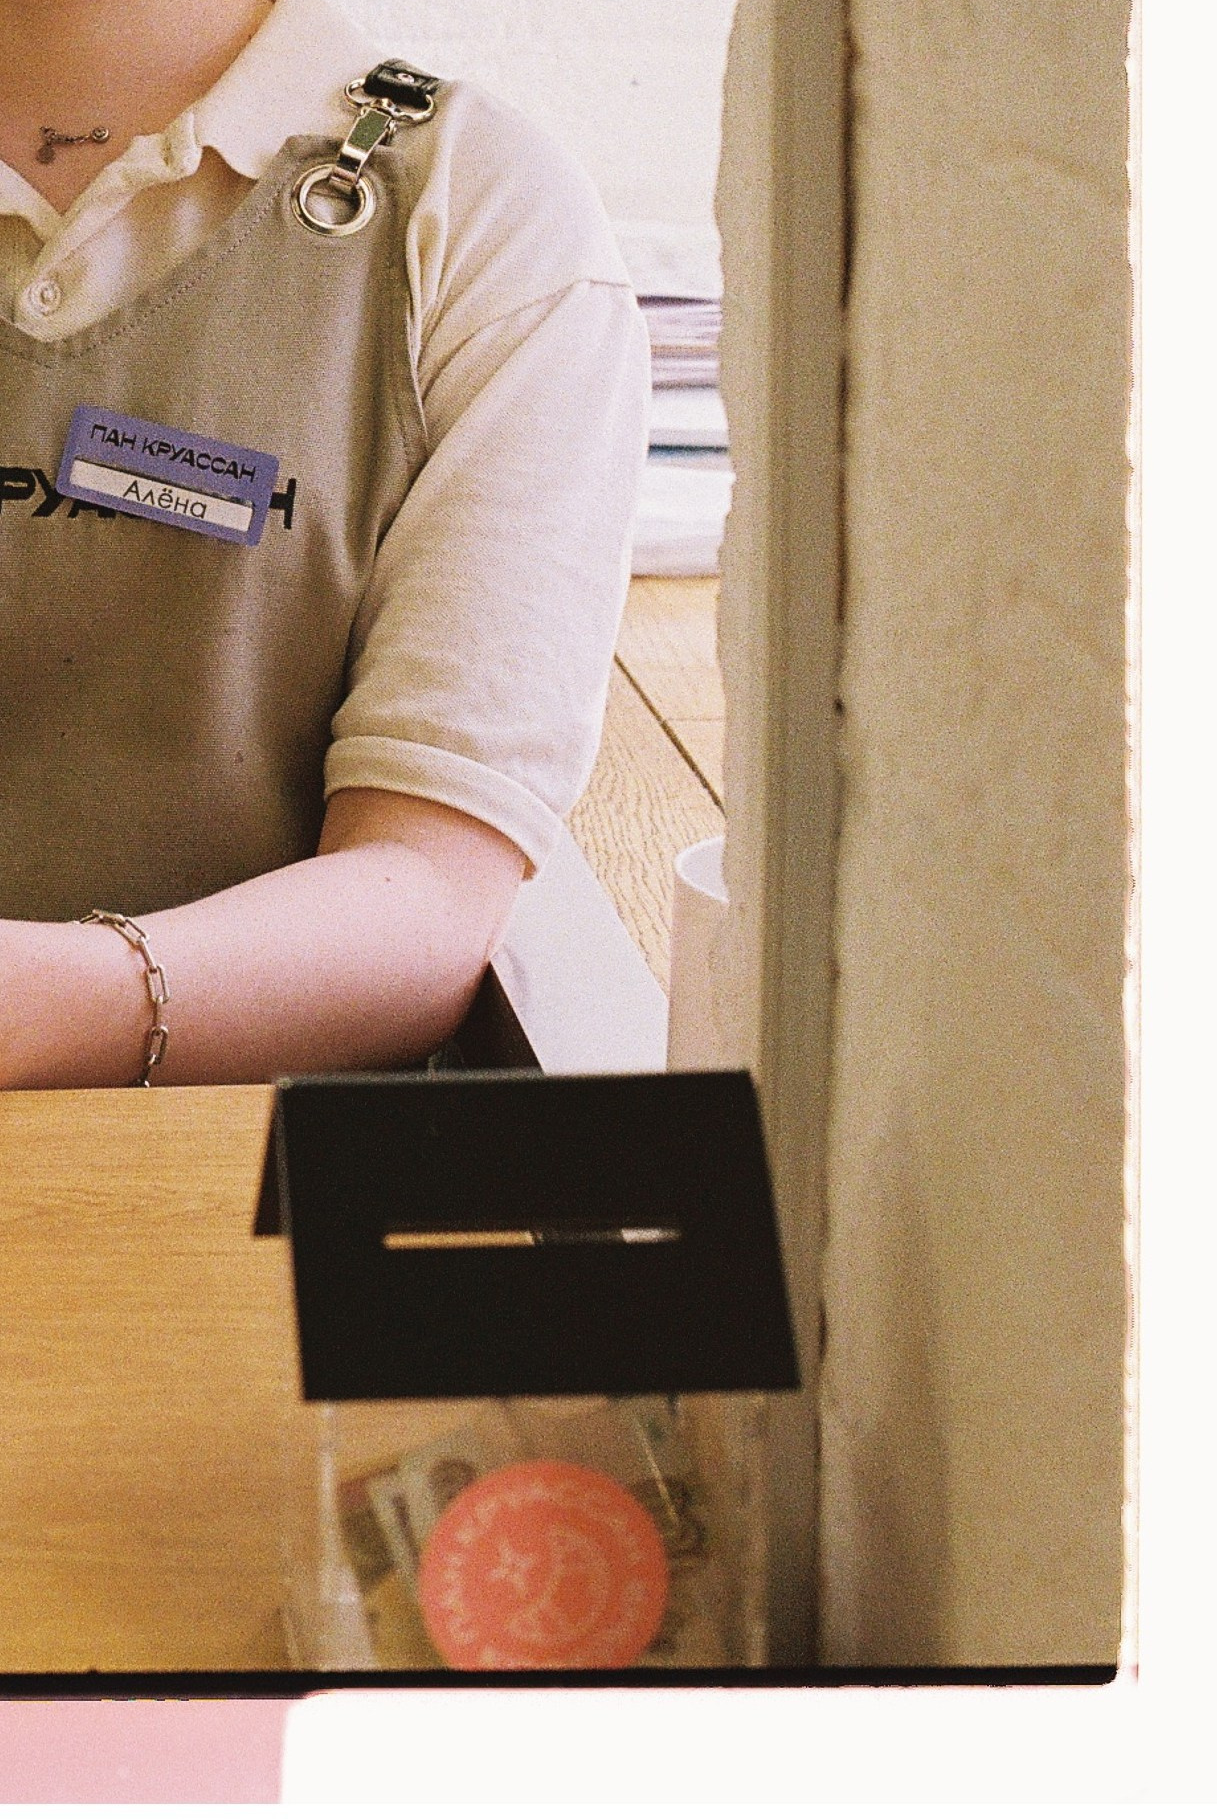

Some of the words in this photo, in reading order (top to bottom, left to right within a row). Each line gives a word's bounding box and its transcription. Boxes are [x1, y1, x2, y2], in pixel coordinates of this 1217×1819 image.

[90, 423, 137, 451] ПАН
[142, 437, 257, 483] КРУАССАН
[122, 480, 208, 520] Алёна
